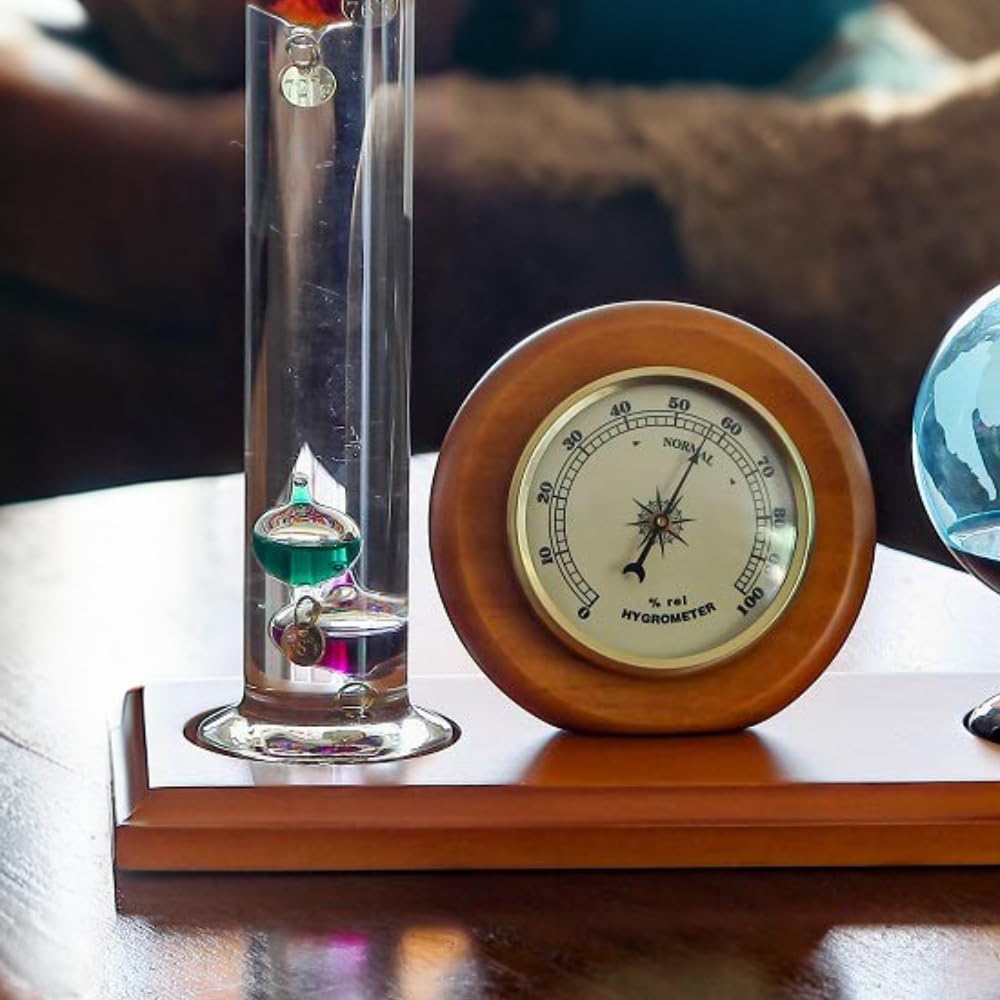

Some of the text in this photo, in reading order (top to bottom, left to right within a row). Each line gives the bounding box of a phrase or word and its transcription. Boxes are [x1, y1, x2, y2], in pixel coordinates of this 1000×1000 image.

[610, 401, 632, 417] 40
[668, 397, 690, 412] 50
[721, 417, 742, 435] 60
[562, 430, 583, 451] 30
[758, 455, 775, 479] 70
[537, 482, 553, 505] 20
[539, 546, 554, 566] 10
[737, 587, 764, 616] 100
[577, 606, 592, 621] 0
[621, 602, 717, 624] HYGROMETER
